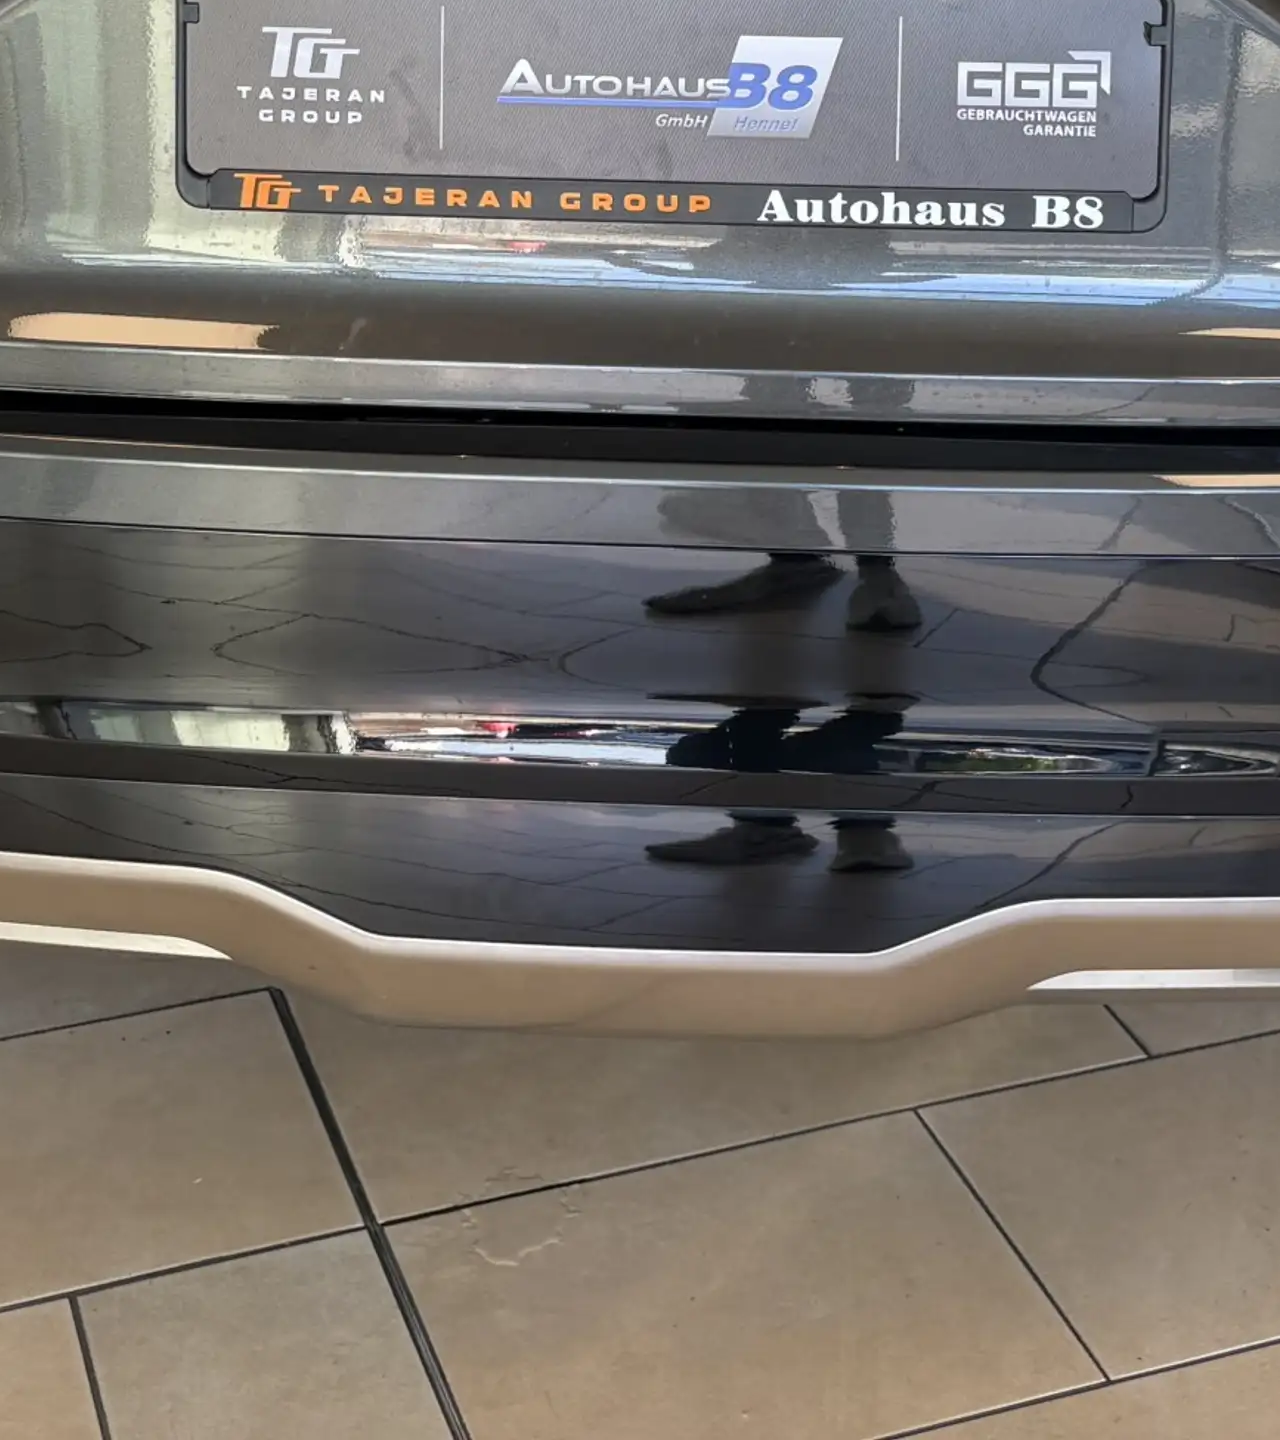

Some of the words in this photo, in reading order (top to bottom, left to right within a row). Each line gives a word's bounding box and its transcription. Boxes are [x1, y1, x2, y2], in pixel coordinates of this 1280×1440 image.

[262, 26, 361, 79] TG
[236, 85, 386, 104] TAJERAN
[719, 62, 818, 111] B8
[956, 62, 1099, 108] GGG
[258, 109, 363, 124] GROUP
[655, 114, 708, 129] GmbH
[956, 108, 1097, 123] GEBRAUCHTWAGEN
[1023, 124, 1097, 138] GARANTIE
[234, 172, 301, 210] TG
[318, 184, 532, 209] TAJERAN
[559, 191, 712, 213] GROUP
[756, 189, 1006, 228] Autohaus
[1031, 194, 1105, 229] B8
